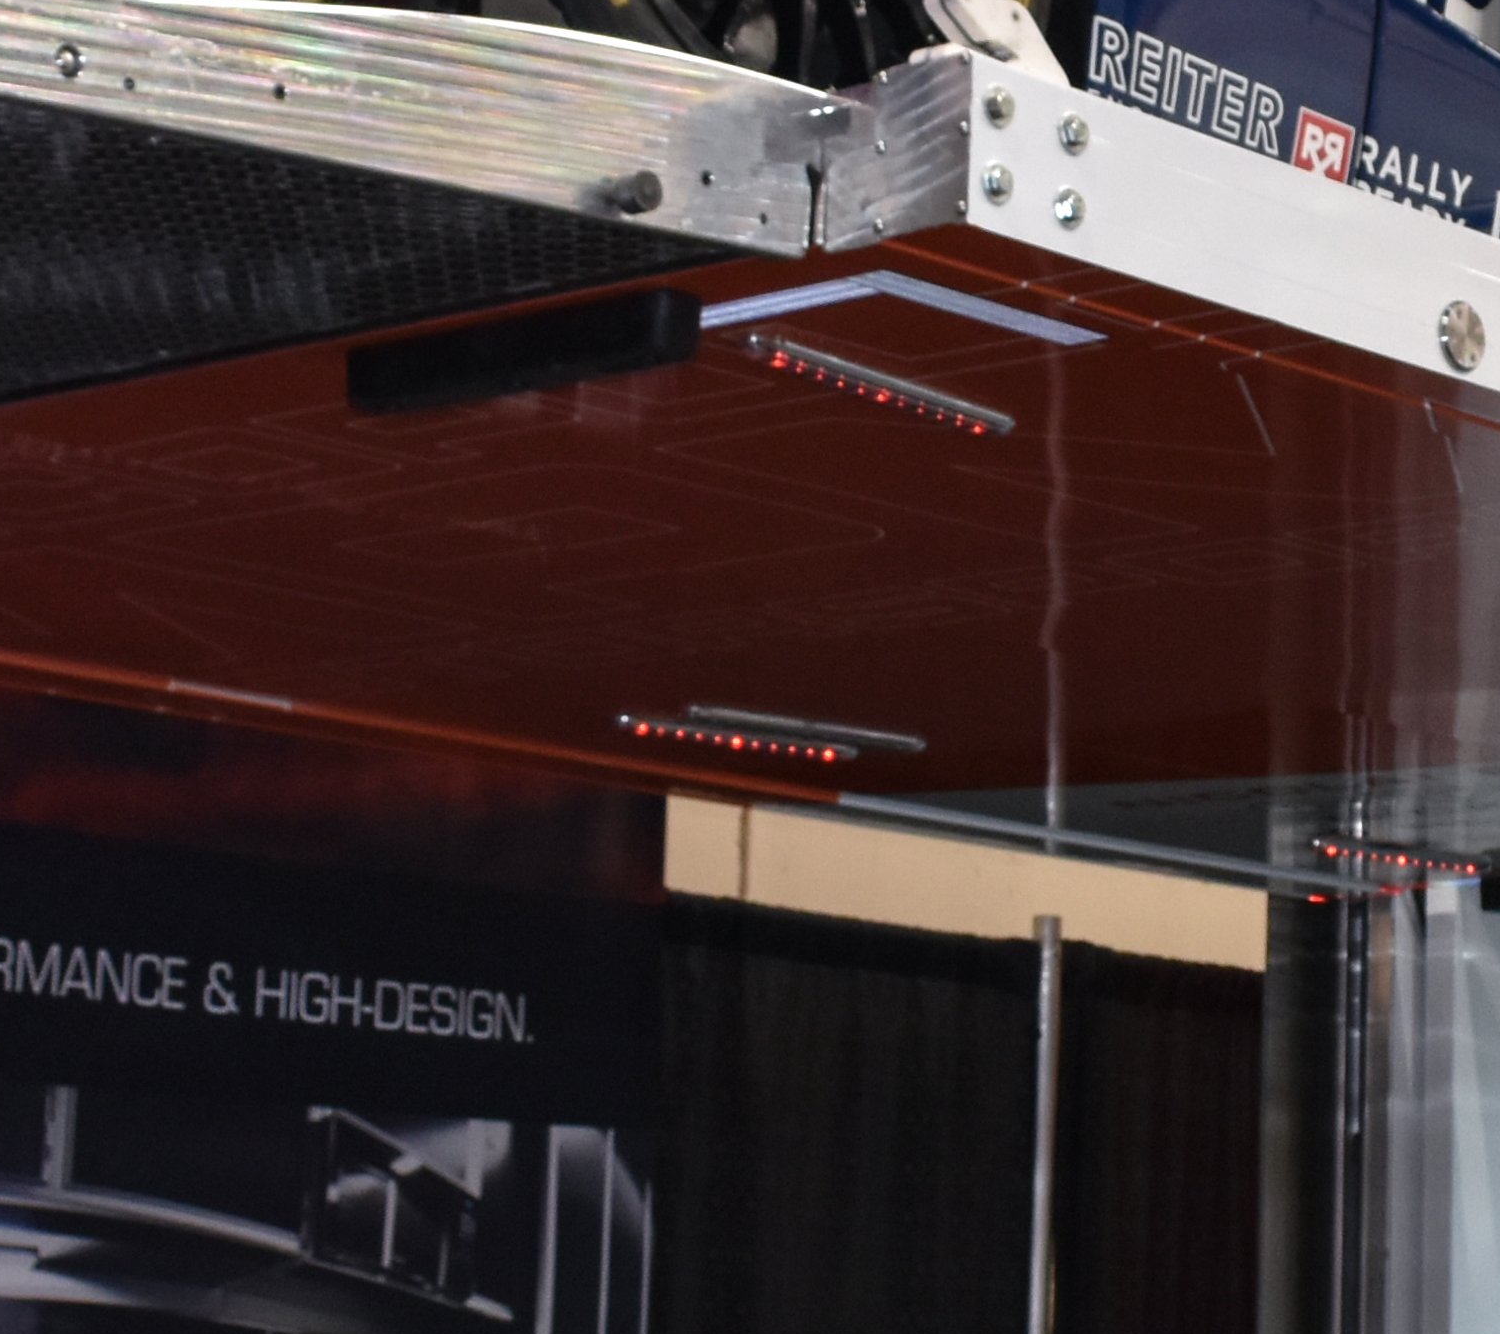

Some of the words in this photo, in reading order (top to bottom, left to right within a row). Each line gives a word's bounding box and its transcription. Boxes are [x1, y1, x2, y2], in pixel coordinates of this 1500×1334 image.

[1089, 15, 1285, 156] REITER
[1355, 134, 1474, 208] RALLY
[202, 963, 238, 1015] &
[255, 967, 535, 1044] HIGH-DESIGN.
